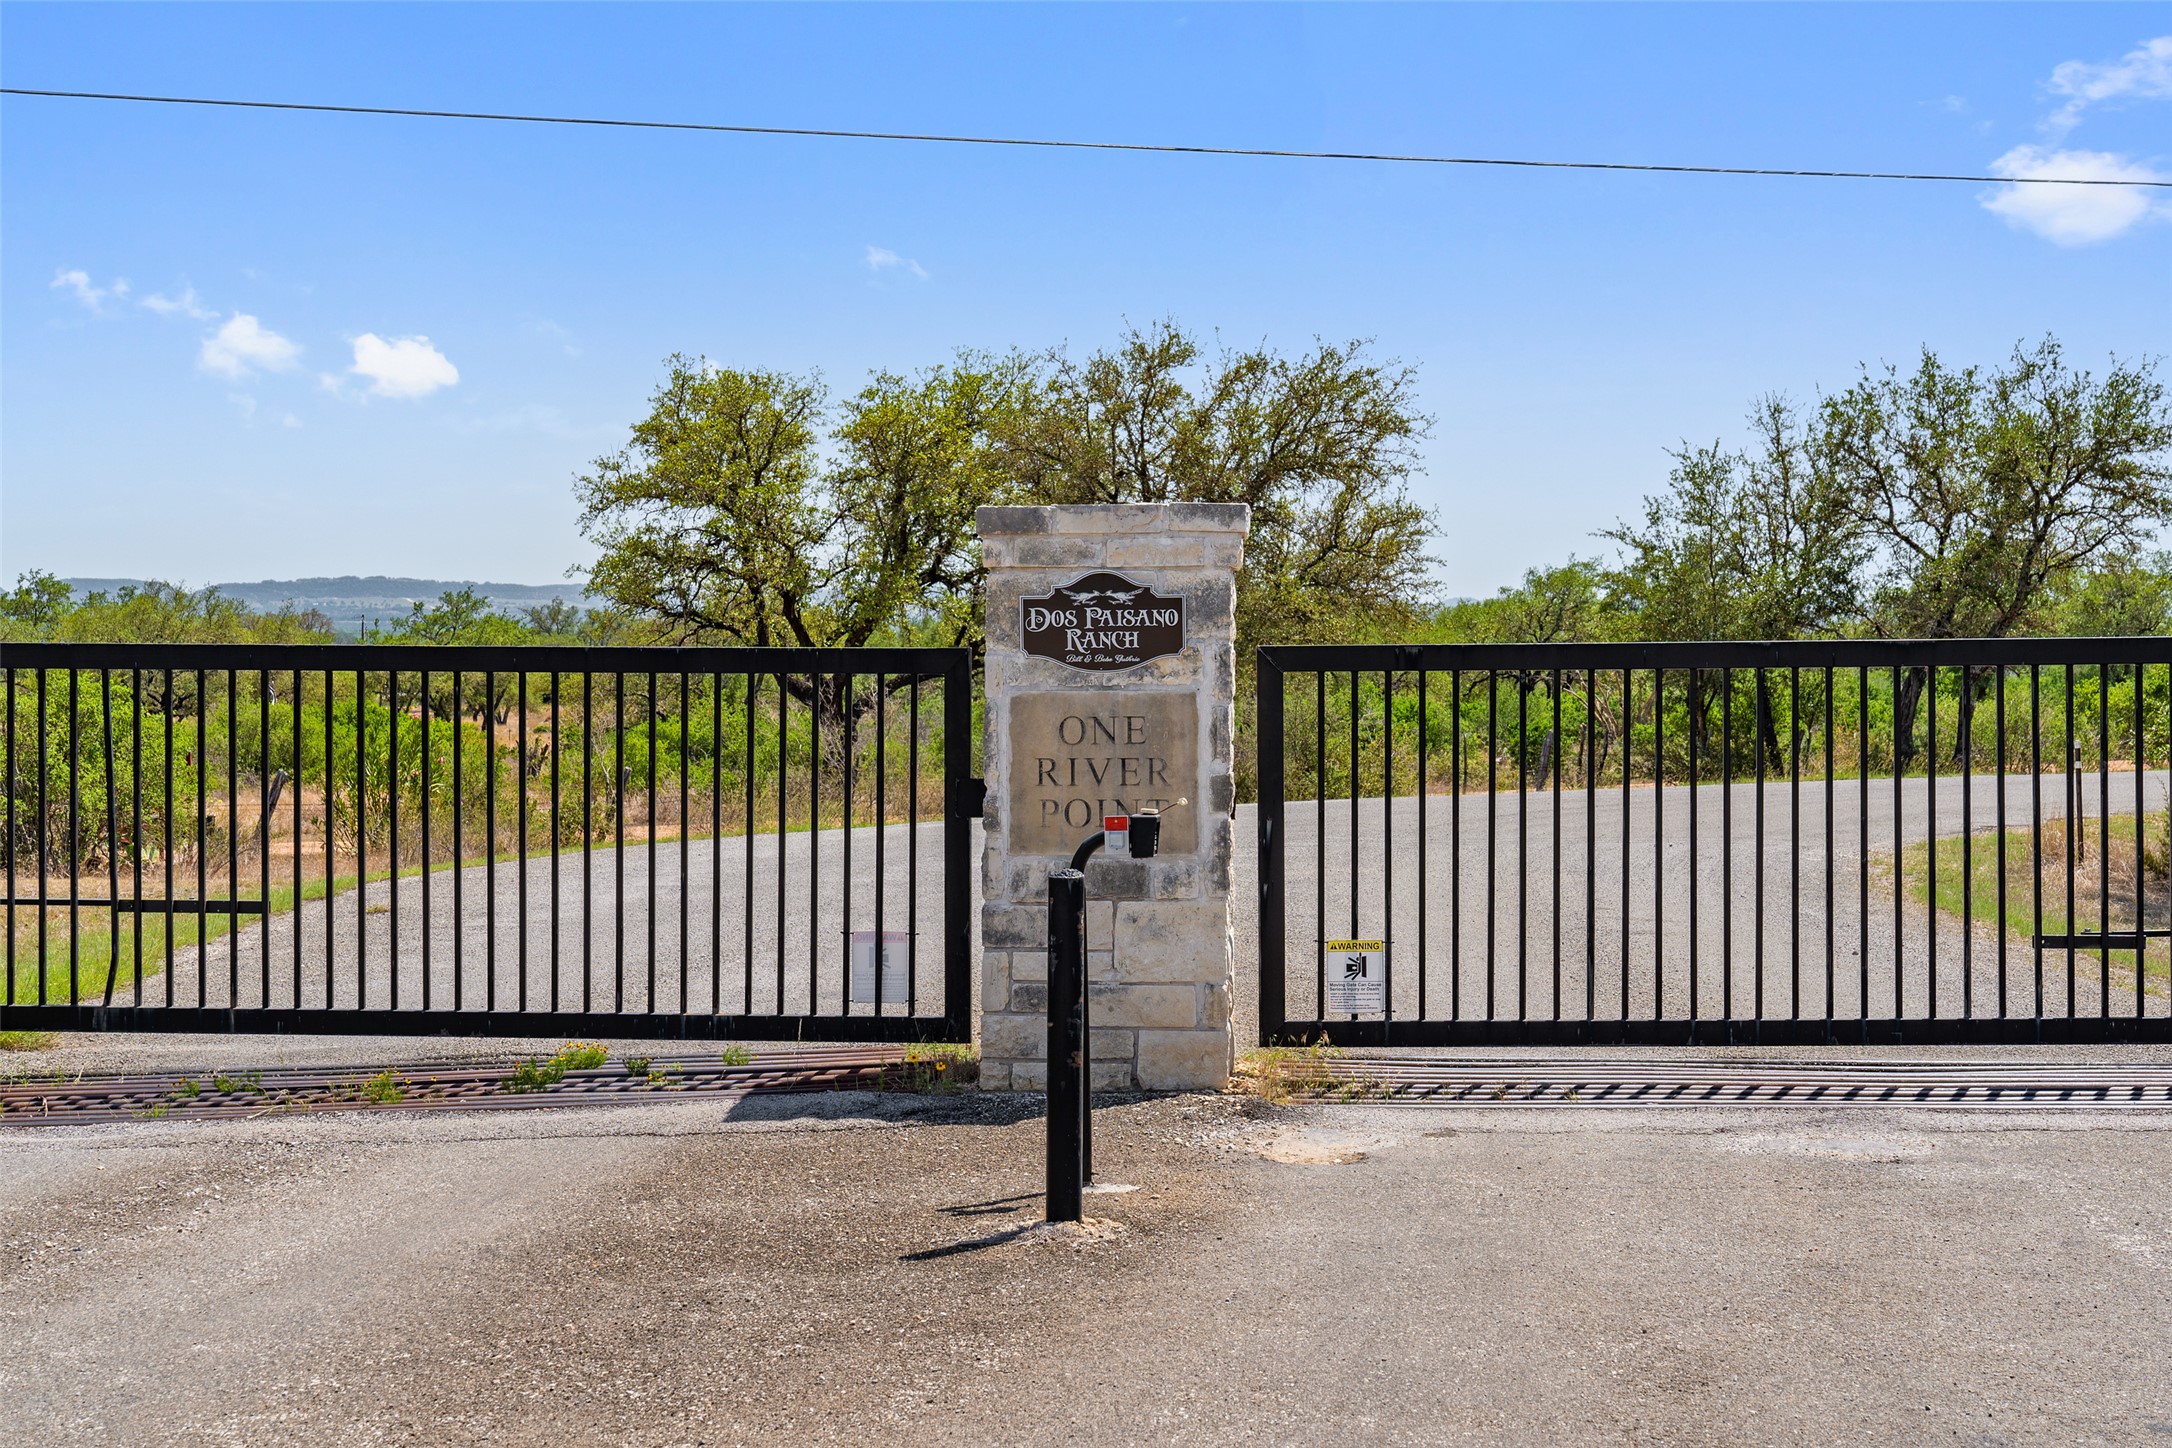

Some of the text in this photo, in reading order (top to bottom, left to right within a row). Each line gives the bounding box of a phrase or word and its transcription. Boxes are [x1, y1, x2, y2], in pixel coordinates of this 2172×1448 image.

[1084, 606, 1179, 630] PAISANO
[1065, 628, 1140, 654] RANCH
[1065, 653, 1084, 663] Bill
[1083, 654, 1092, 663] &
[1058, 715, 1147, 746] ONE
[1035, 757, 1171, 787] RIVER
[1337, 942, 1380, 950] WARNING
